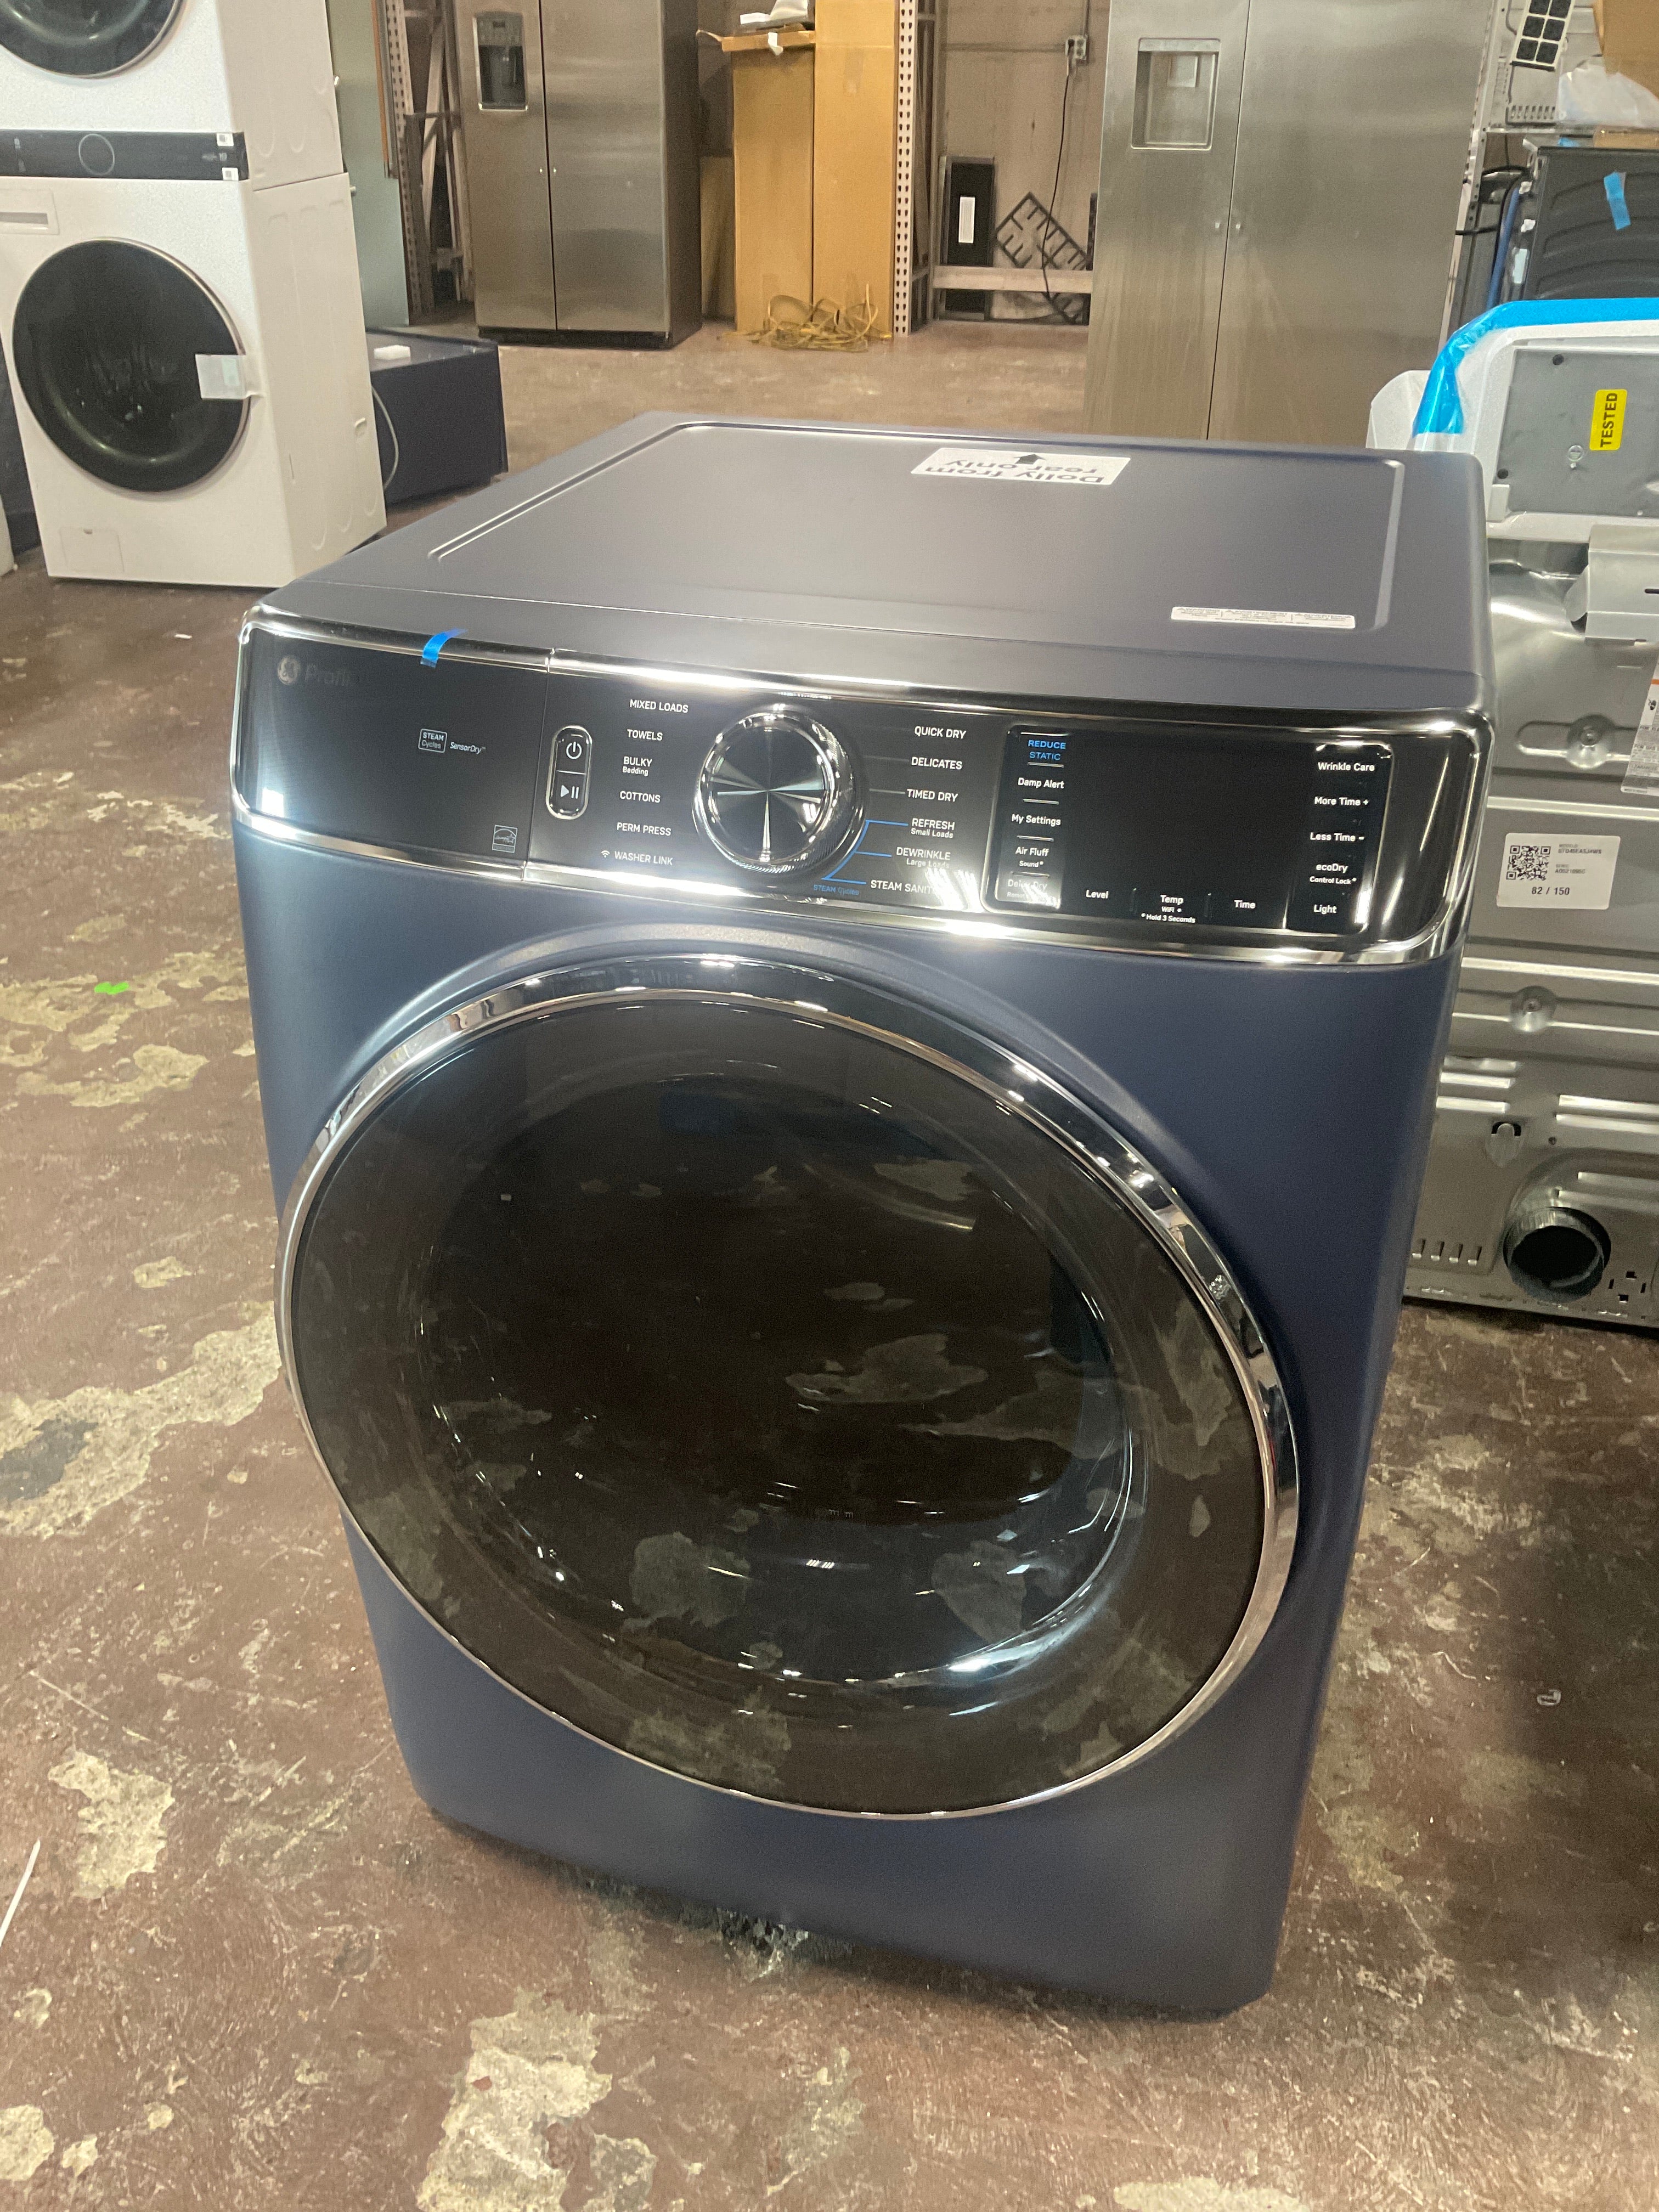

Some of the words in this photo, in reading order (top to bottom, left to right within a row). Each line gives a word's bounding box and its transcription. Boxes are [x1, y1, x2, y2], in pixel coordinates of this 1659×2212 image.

[1600, 392, 1618, 448] TESTED
[946, 459, 1017, 469] only
[1028, 465, 1097, 474] rear
[925, 467, 1003, 477] from
[1015, 471, 1105, 483] Dolly
[629, 699, 657, 710] MIXED
[659, 702, 689, 713] LOADS
[422, 732, 444, 741] STEAM
[627, 729, 663, 741] TOWELS
[914, 726, 944, 737] QUICK
[945, 729, 967, 740] DRY
[421, 740, 441, 749] Cycles
[1028, 740, 1066, 750] REDUCE
[1029, 751, 1061, 761] STATIC
[623, 756, 653, 768] BULKY
[911, 757, 963, 770] DELICATES
[1318, 761, 1351, 771] Wrinkle
[1353, 763, 1375, 772] Care
[622, 766, 649, 777] Bedding
[1018, 777, 1042, 789] Damp
[1043, 779, 1065, 789] Alert
[620, 791, 661, 803] COTTONS
[907, 788, 935, 801] TIMED
[938, 792, 958, 803] DRY
[1314, 796, 1337, 805] More
[1339, 797, 1361, 806] Time
[911, 817, 955, 831] REFRESH
[1011, 814, 1024, 825] My
[1025, 815, 1062, 827] Settings
[617, 822, 640, 833] PERM
[642, 825, 672, 836] PRESS
[911, 828, 930, 837] Small
[932, 830, 953, 839] Loads
[1310, 832, 1331, 841] Less
[1334, 833, 1356, 842] Time
[896, 847, 951, 861] DEWRINKLE
[1015, 847, 1028, 855] Air
[1029, 848, 1049, 857] Fluff
[614, 851, 651, 864] WASHER
[653, 855, 673, 866] LINK
[906, 857, 926, 867] Large
[928, 860, 950, 869] Loads
[1316, 863, 1348, 874] ecoDry
[813, 884, 836, 893] STEAM
[870, 879, 902, 891] STEAM
[905, 883, 934, 894] SANIT
[1033, 881, 1047, 891] Dry
[1531, 887, 1543, 895] 82
[1554, 887, 1570, 895] 150
[1086, 889, 1109, 899] Level
[1160, 894, 1183, 905] Temp
[1234, 899, 1256, 910] Time
[1313, 904, 1337, 915] Light
[1146, 913, 1161, 922] Hold
[1168, 915, 1196, 924] Seconds
